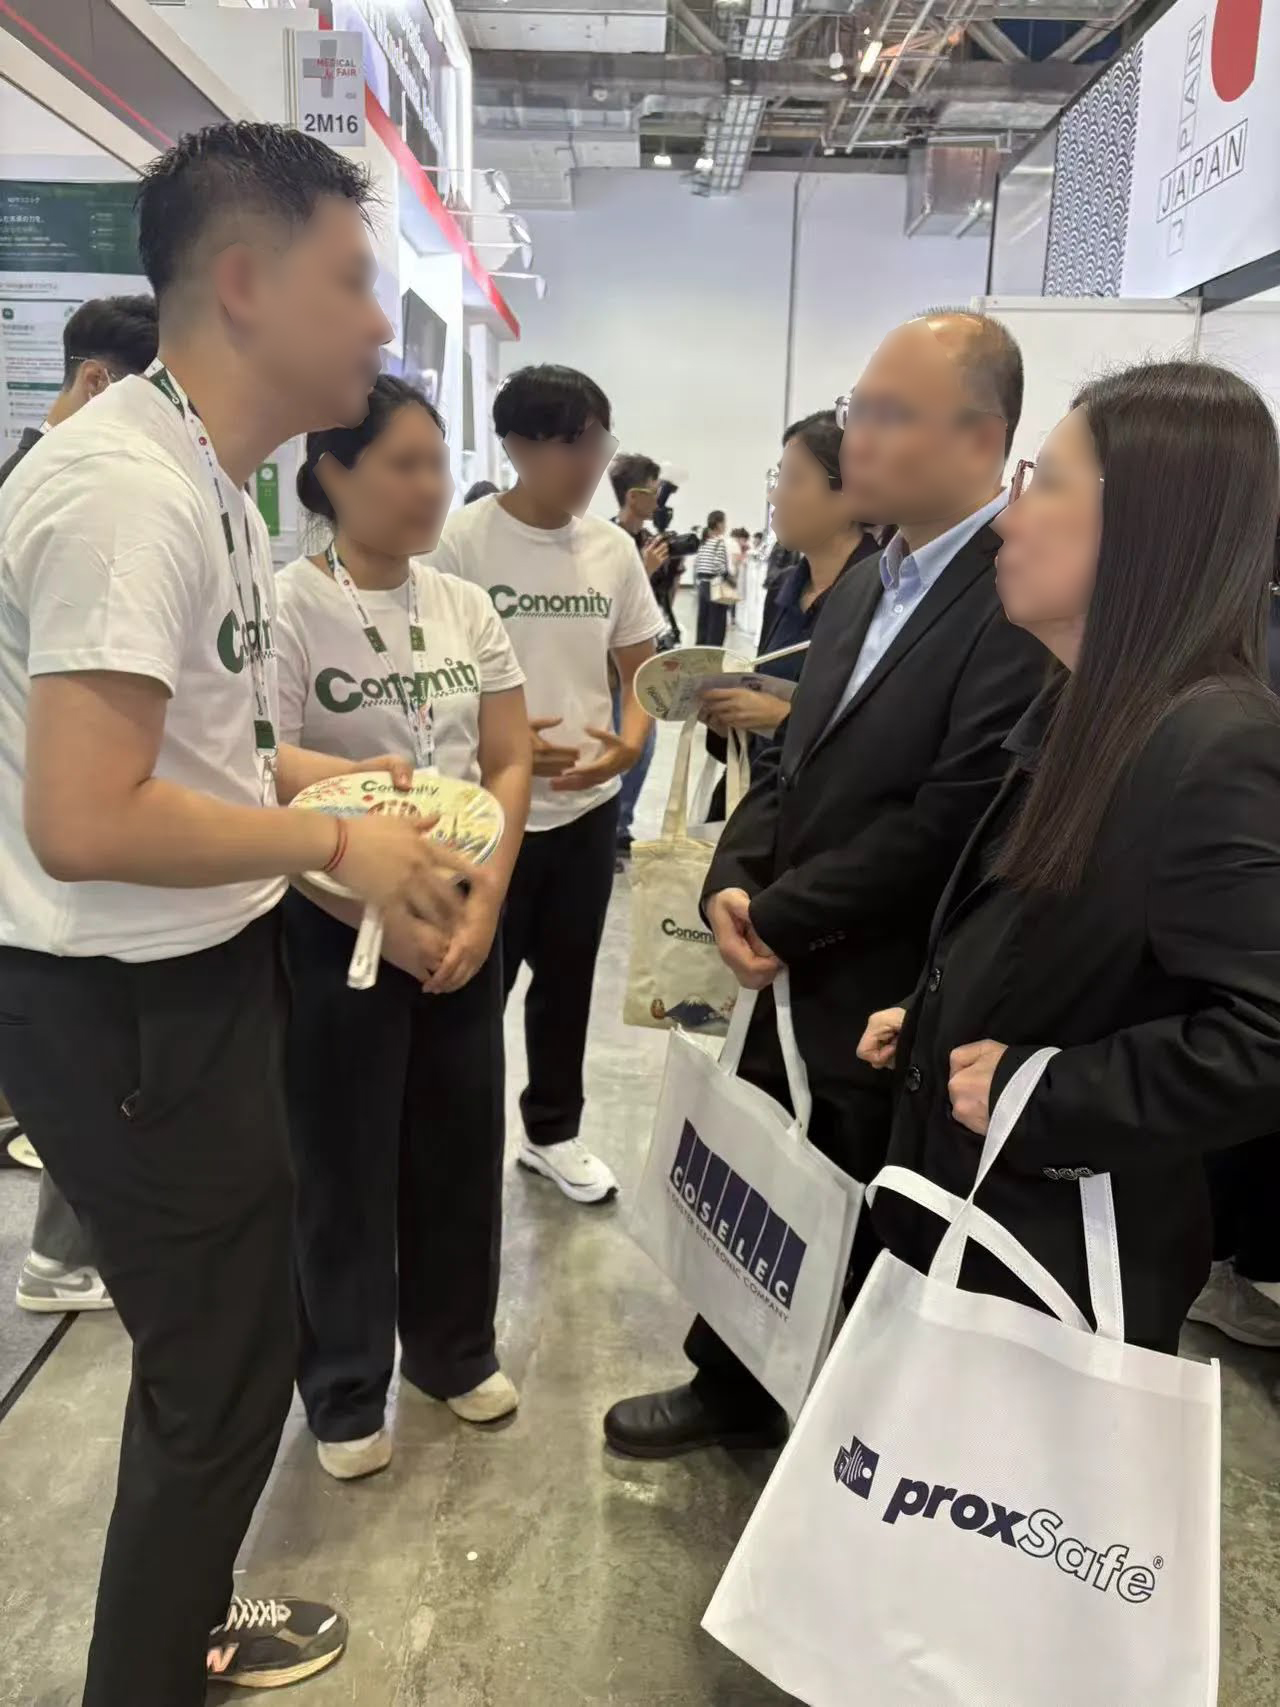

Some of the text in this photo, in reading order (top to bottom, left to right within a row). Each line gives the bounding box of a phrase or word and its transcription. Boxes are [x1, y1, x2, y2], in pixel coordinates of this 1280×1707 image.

[336, 68, 357, 77] FAIR
[304, 114, 358, 133] 2M16
[1161, 127, 1244, 213] JAPAN
[488, 585, 612, 618] Conomity
[661, 918, 717, 943] Conom
[672, 1165, 790, 1303] COSELEC
[743, 1277, 790, 1322] COMPANY
